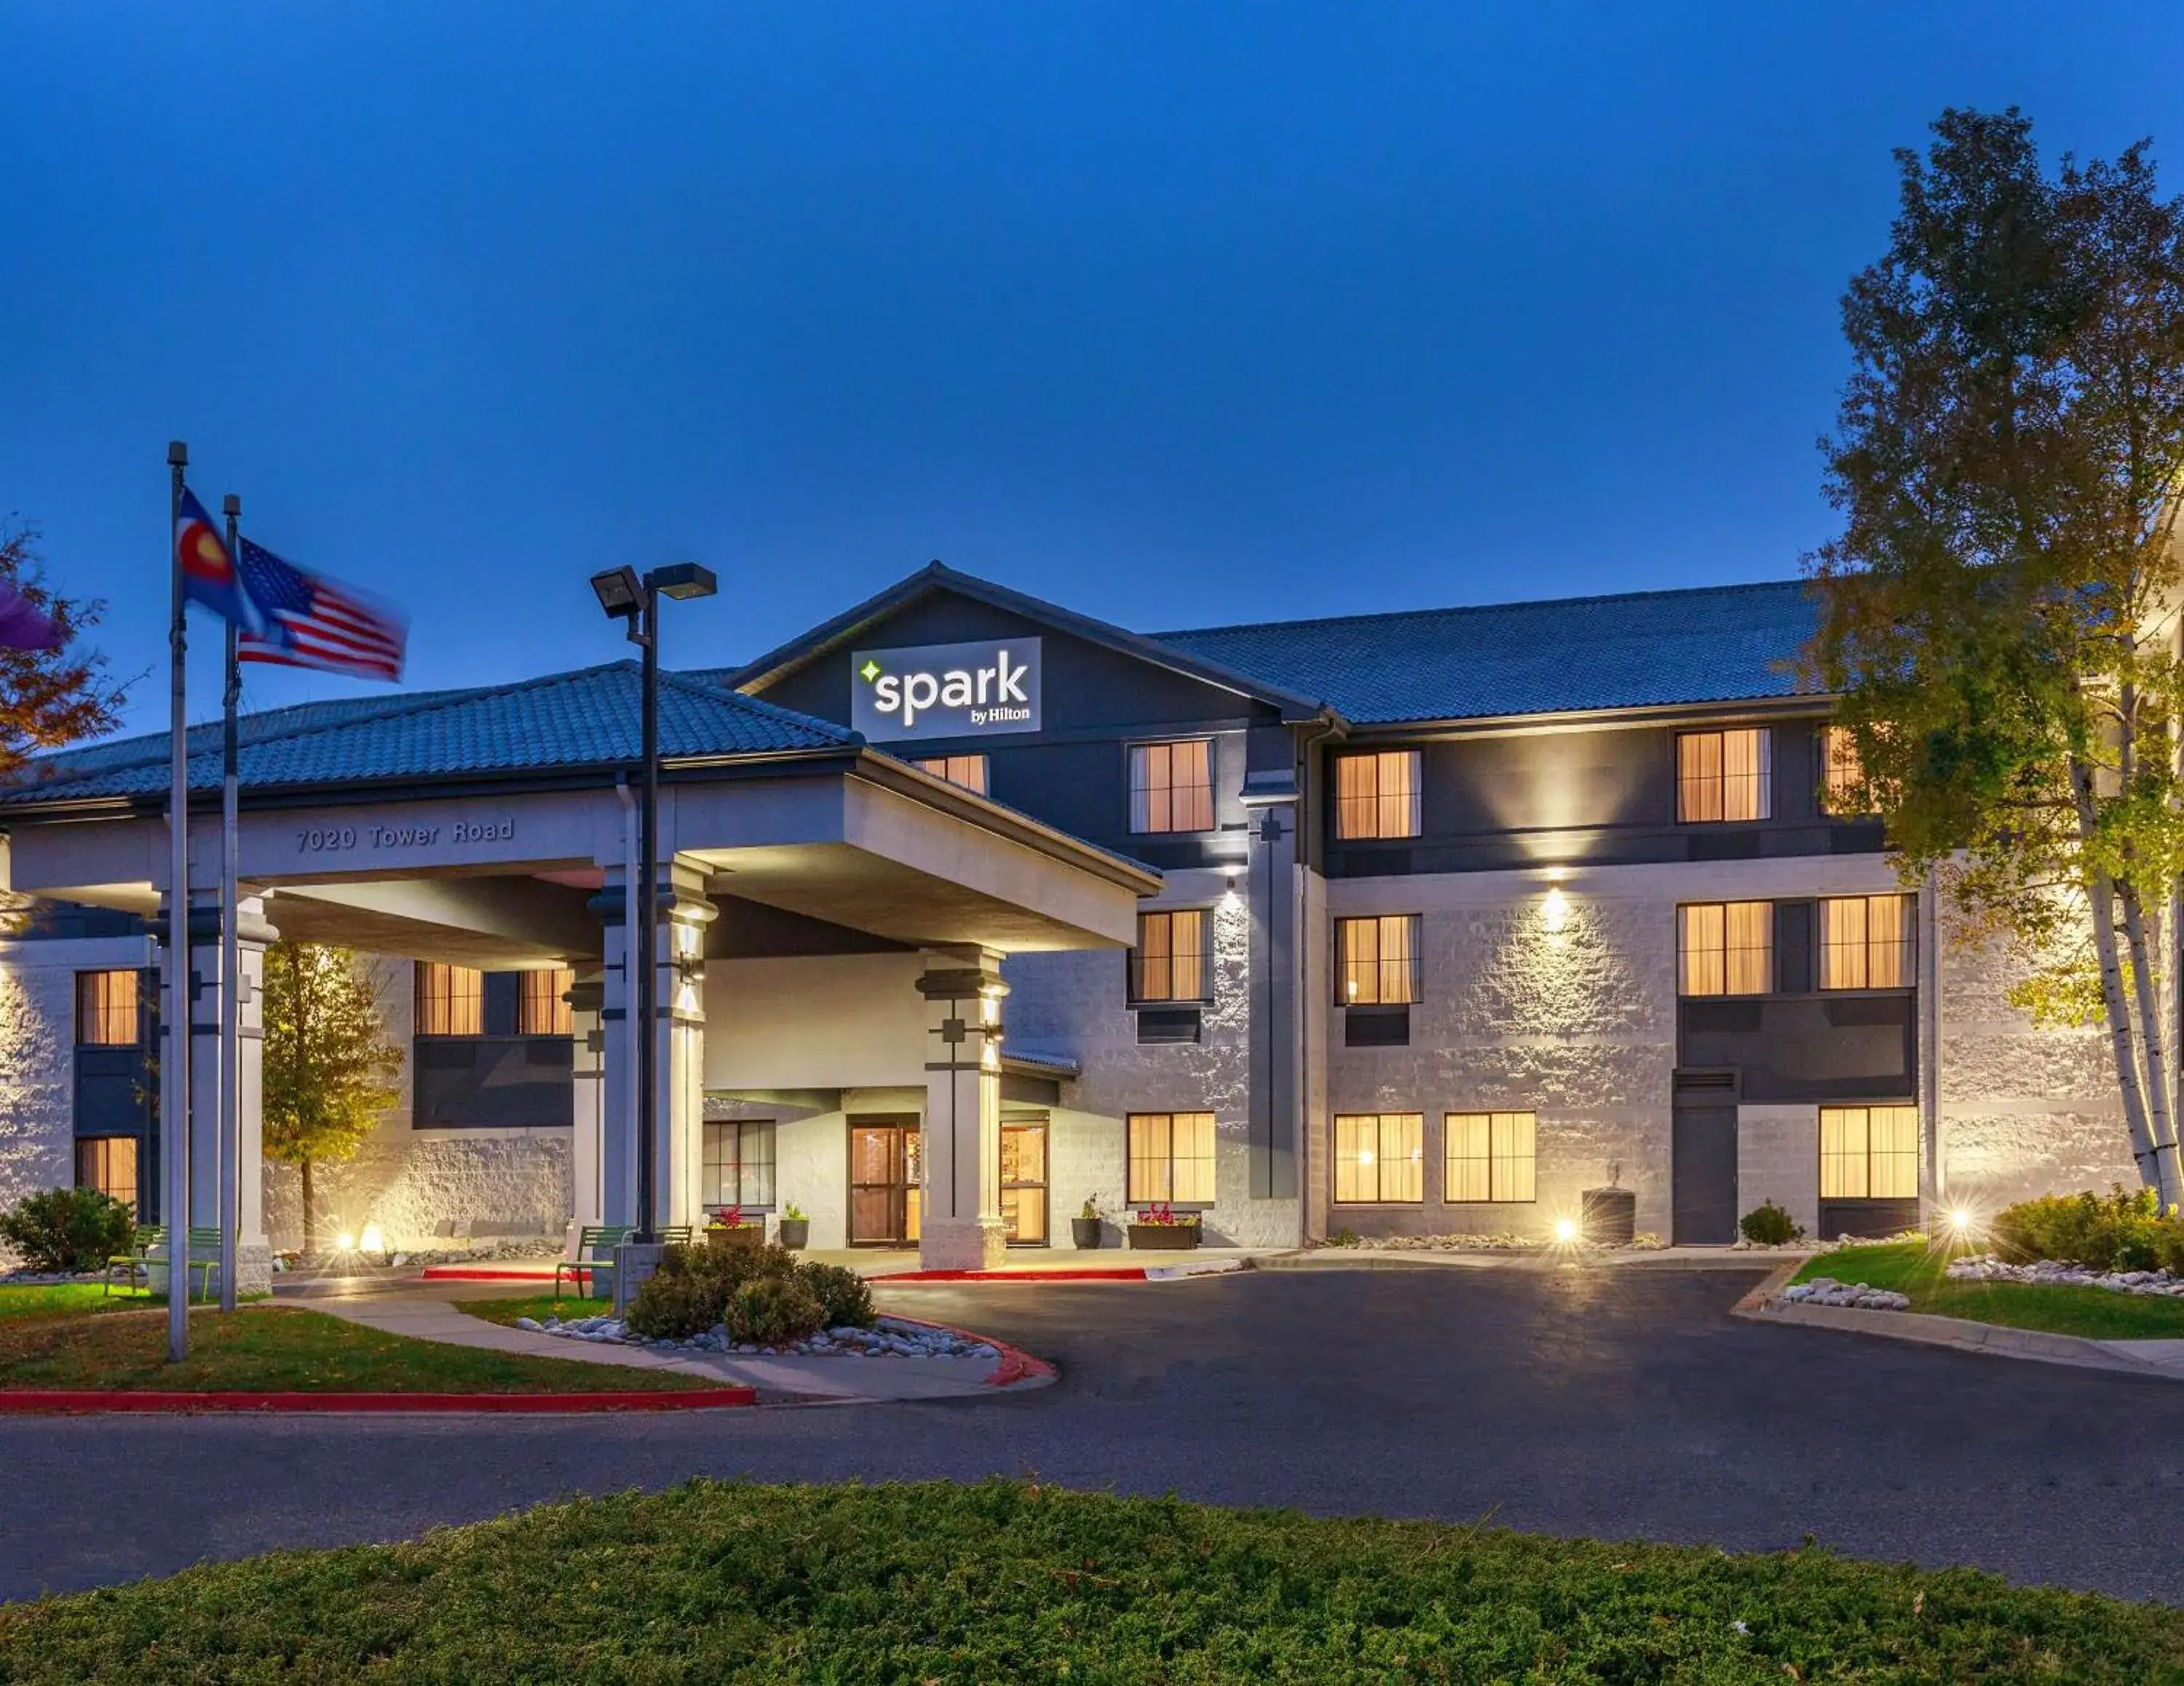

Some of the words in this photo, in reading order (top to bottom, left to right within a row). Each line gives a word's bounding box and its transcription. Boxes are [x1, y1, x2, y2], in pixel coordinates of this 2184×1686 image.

[875, 650, 1028, 727] spark
[971, 711, 986, 724] by
[989, 707, 1030, 721] Hilton
[298, 827, 357, 852] 7020
[371, 826, 440, 848] Tower
[453, 818, 514, 842] Road
